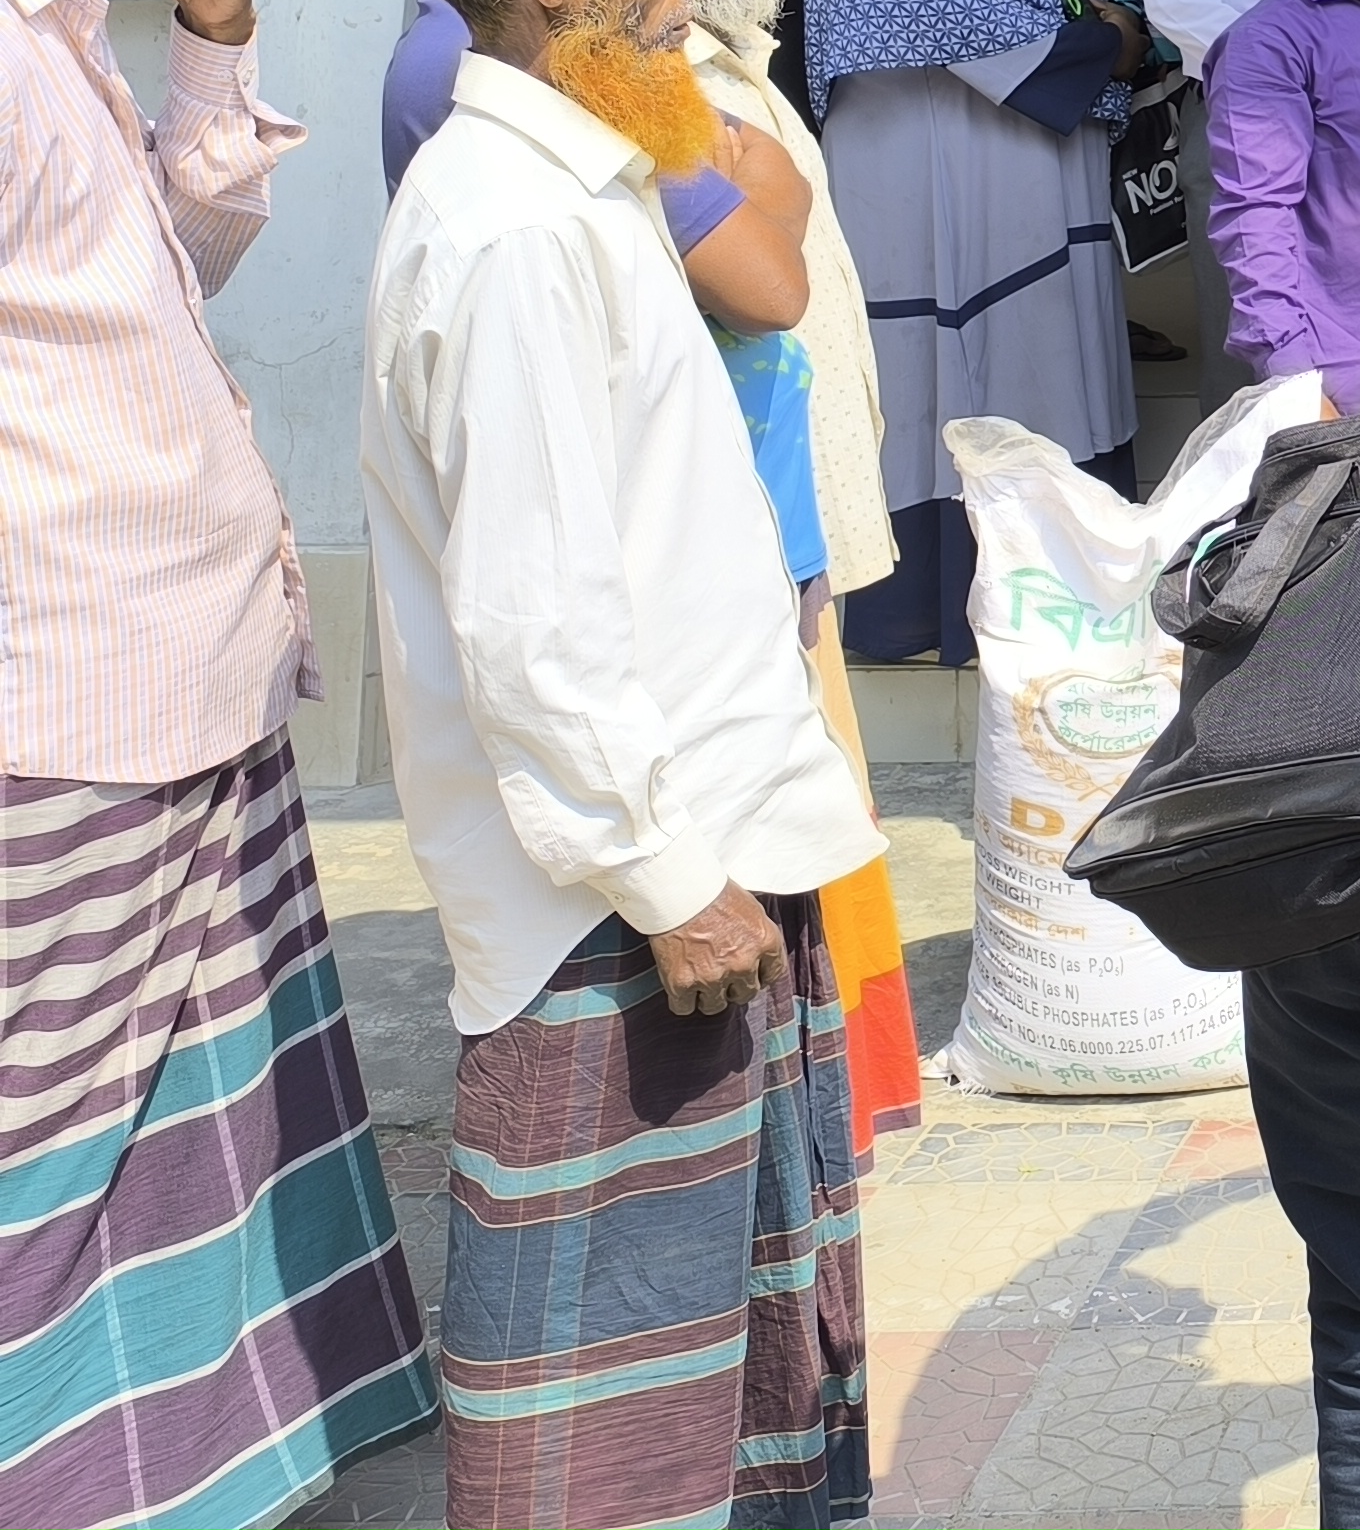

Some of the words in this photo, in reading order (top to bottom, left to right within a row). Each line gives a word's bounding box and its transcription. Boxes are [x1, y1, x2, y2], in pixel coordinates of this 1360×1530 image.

[1057, 697, 1094, 723] কৃষি
[1099, 699, 1159, 725] উন্নয়ন
[1058, 720, 1159, 752] কর্পোরেশন
[985, 871, 1044, 910] WEIGHT
[1003, 865, 1076, 896] WEIGHT
[1061, 955, 1081, 976] (as
[1042, 979, 1061, 999] (as
[1065, 984, 1080, 1005] N)
[1043, 1005, 1139, 1028] PHOSPHATES
[1144, 1007, 1165, 1027] (as
[1048, 1062, 1099, 1088] কৃষি
[1103, 1063, 1182, 1085] উন্নয়ন
